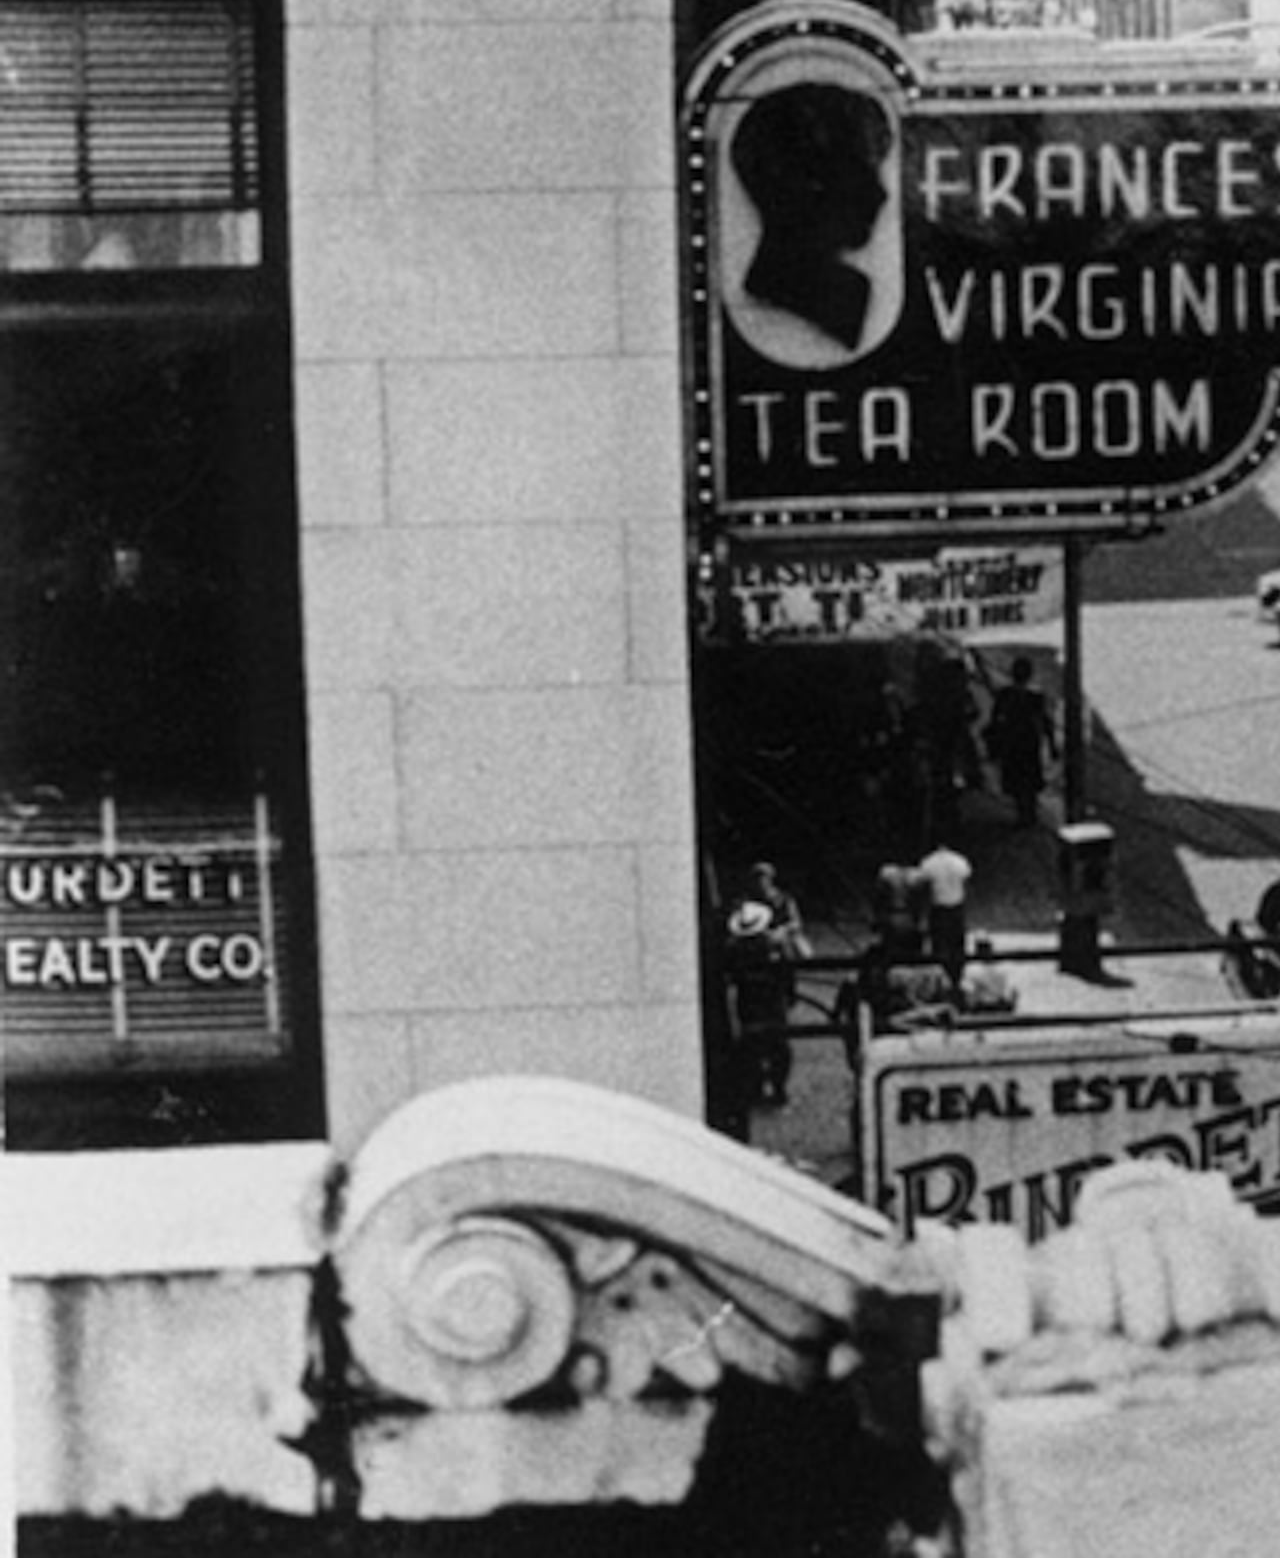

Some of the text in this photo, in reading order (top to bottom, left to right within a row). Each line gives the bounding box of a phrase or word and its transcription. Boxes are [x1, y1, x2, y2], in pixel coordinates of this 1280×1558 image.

[738, 380, 1211, 465] TEA ROOM
[900, 1070, 1243, 1125] REAL ESTATE
